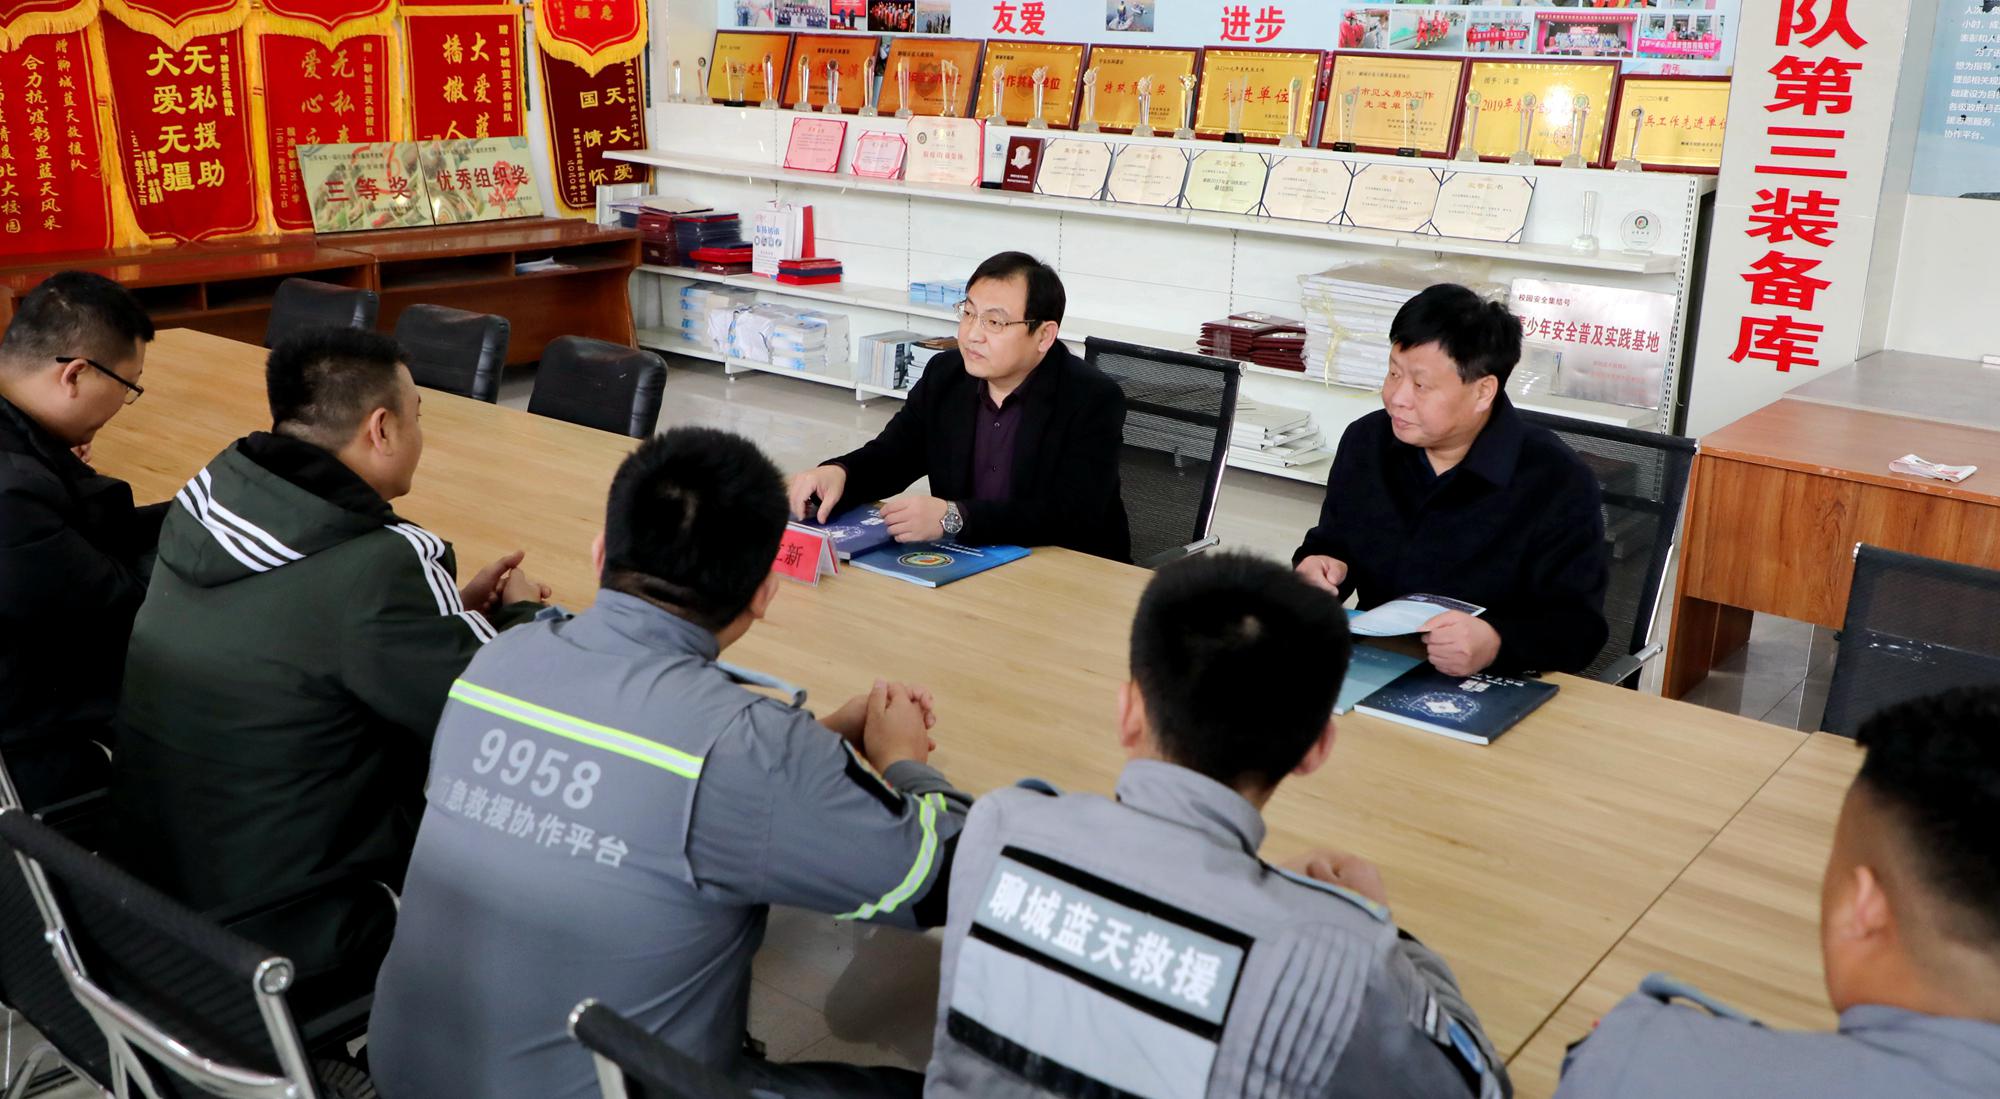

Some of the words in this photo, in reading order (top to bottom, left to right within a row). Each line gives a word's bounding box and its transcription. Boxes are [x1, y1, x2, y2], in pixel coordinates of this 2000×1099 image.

[992, 2, 1047, 36] 友爱
[1220, 5, 1287, 43] 进步
[146, 46, 195, 192] 大爱无疆
[184, 45, 225, 188] 无私援助
[325, 176, 412, 201] 三等奖
[436, 164, 529, 192] 优秀组织奖
[1728, 0, 1868, 373] 队第三装备库
[1518, 293, 1571, 307] 校园安全集结号
[472, 728, 601, 810] 9958
[988, 871, 1223, 1008] 聊城蓝天救援
